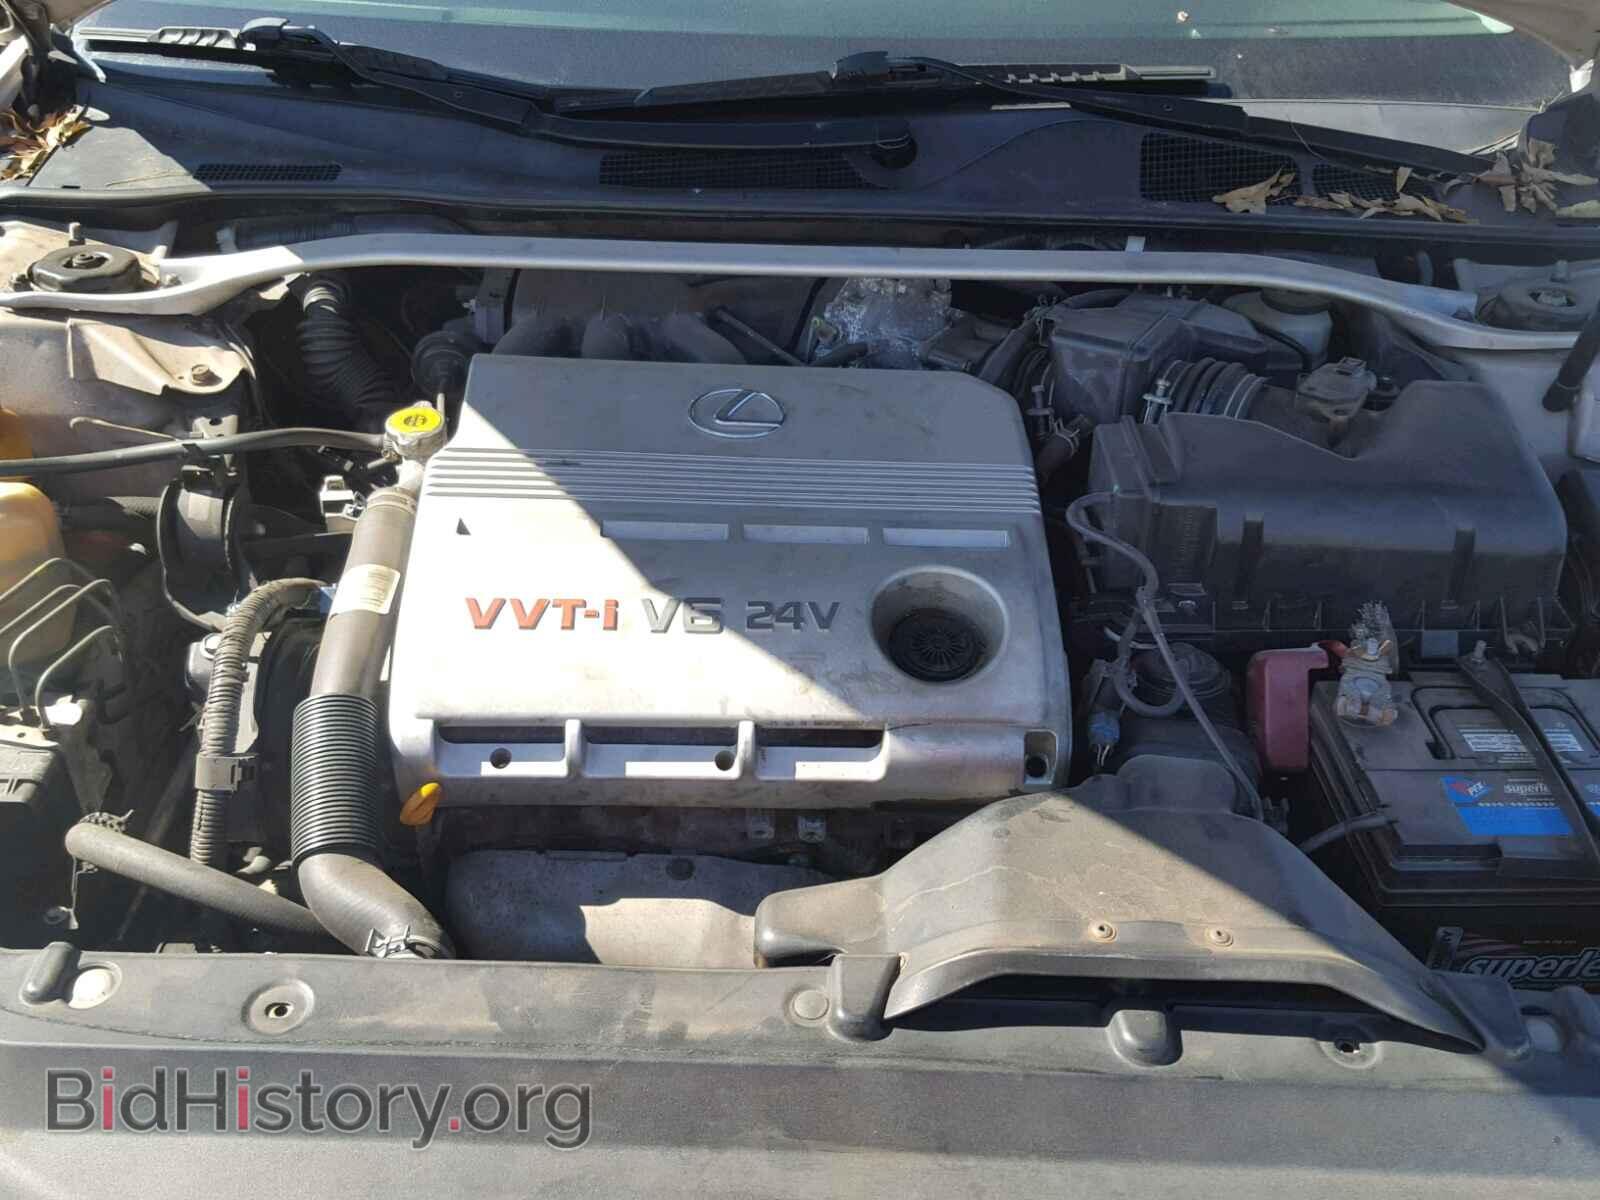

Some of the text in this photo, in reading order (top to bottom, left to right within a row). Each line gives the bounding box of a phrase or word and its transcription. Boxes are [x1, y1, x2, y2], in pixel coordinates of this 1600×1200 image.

[465, 597, 840, 633] VVT-i V6 24V
